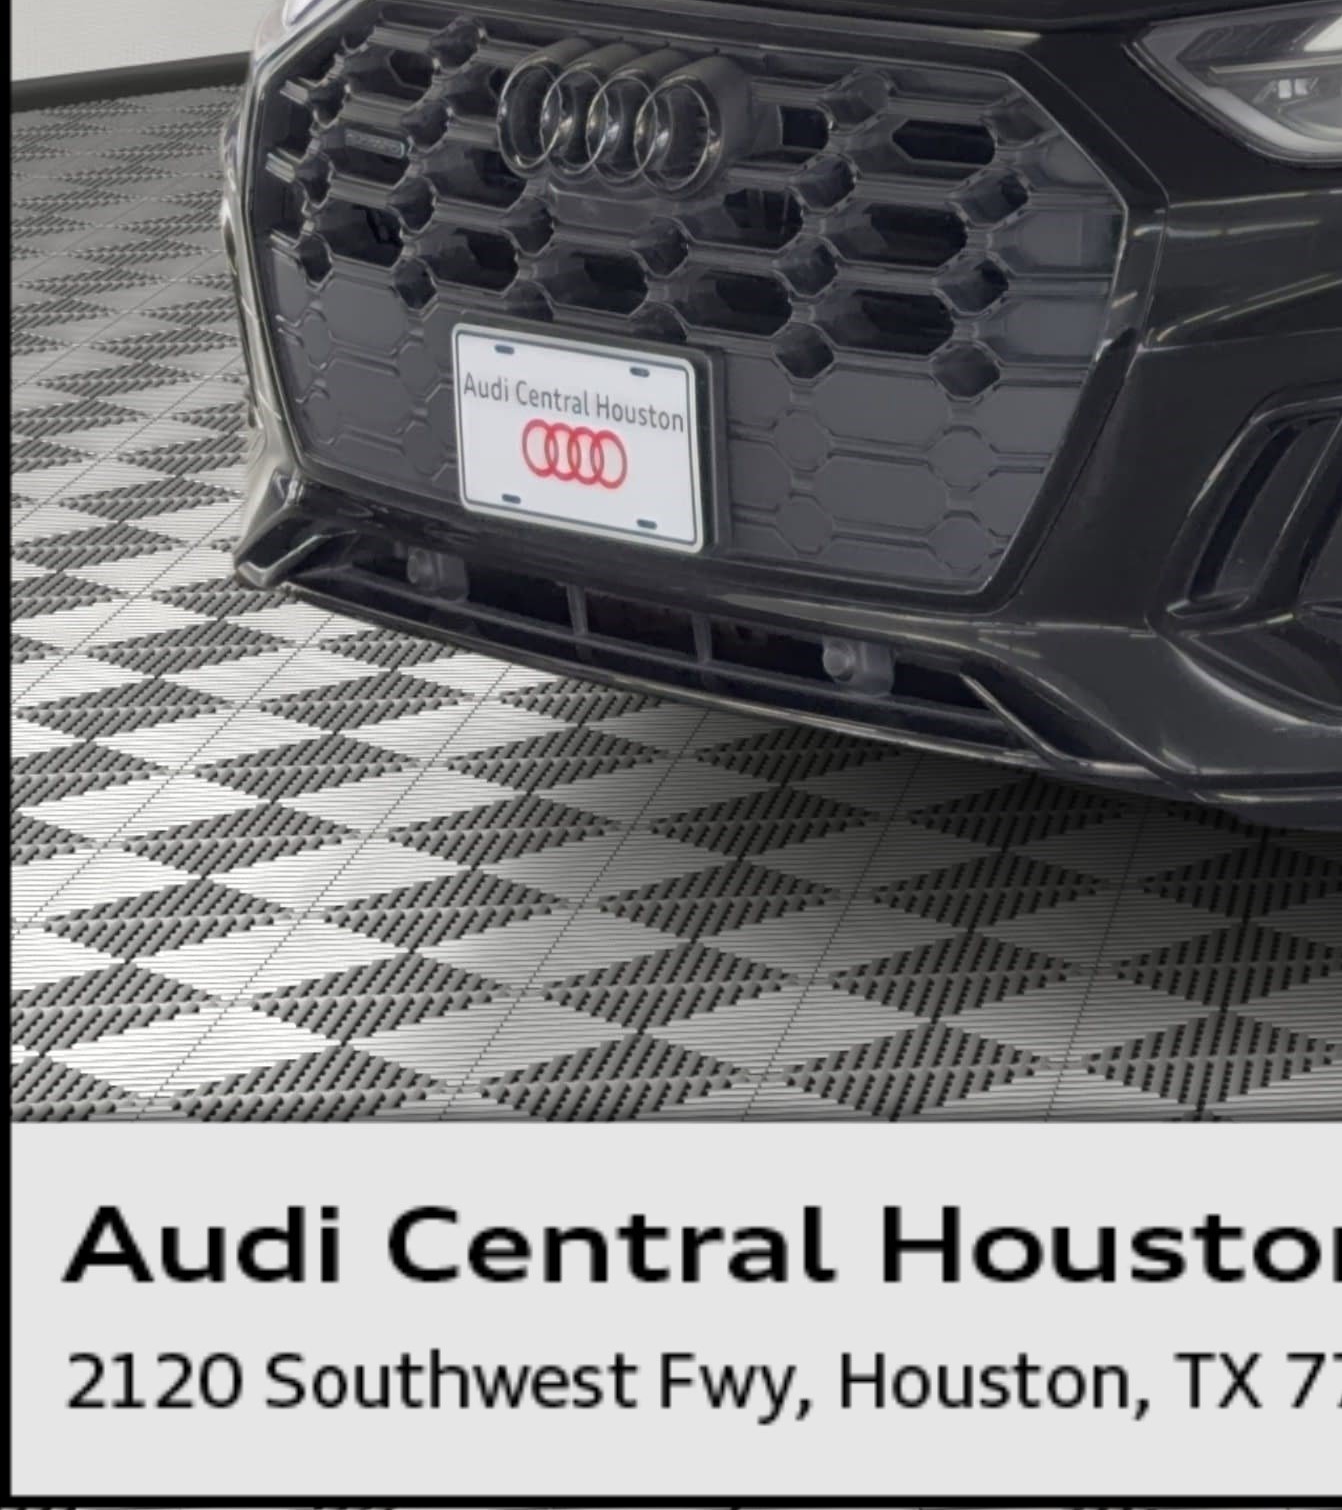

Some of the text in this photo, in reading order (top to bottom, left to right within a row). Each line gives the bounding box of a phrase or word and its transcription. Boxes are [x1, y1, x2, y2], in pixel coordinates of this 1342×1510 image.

[463, 371, 684, 433] Audi Central Houston
